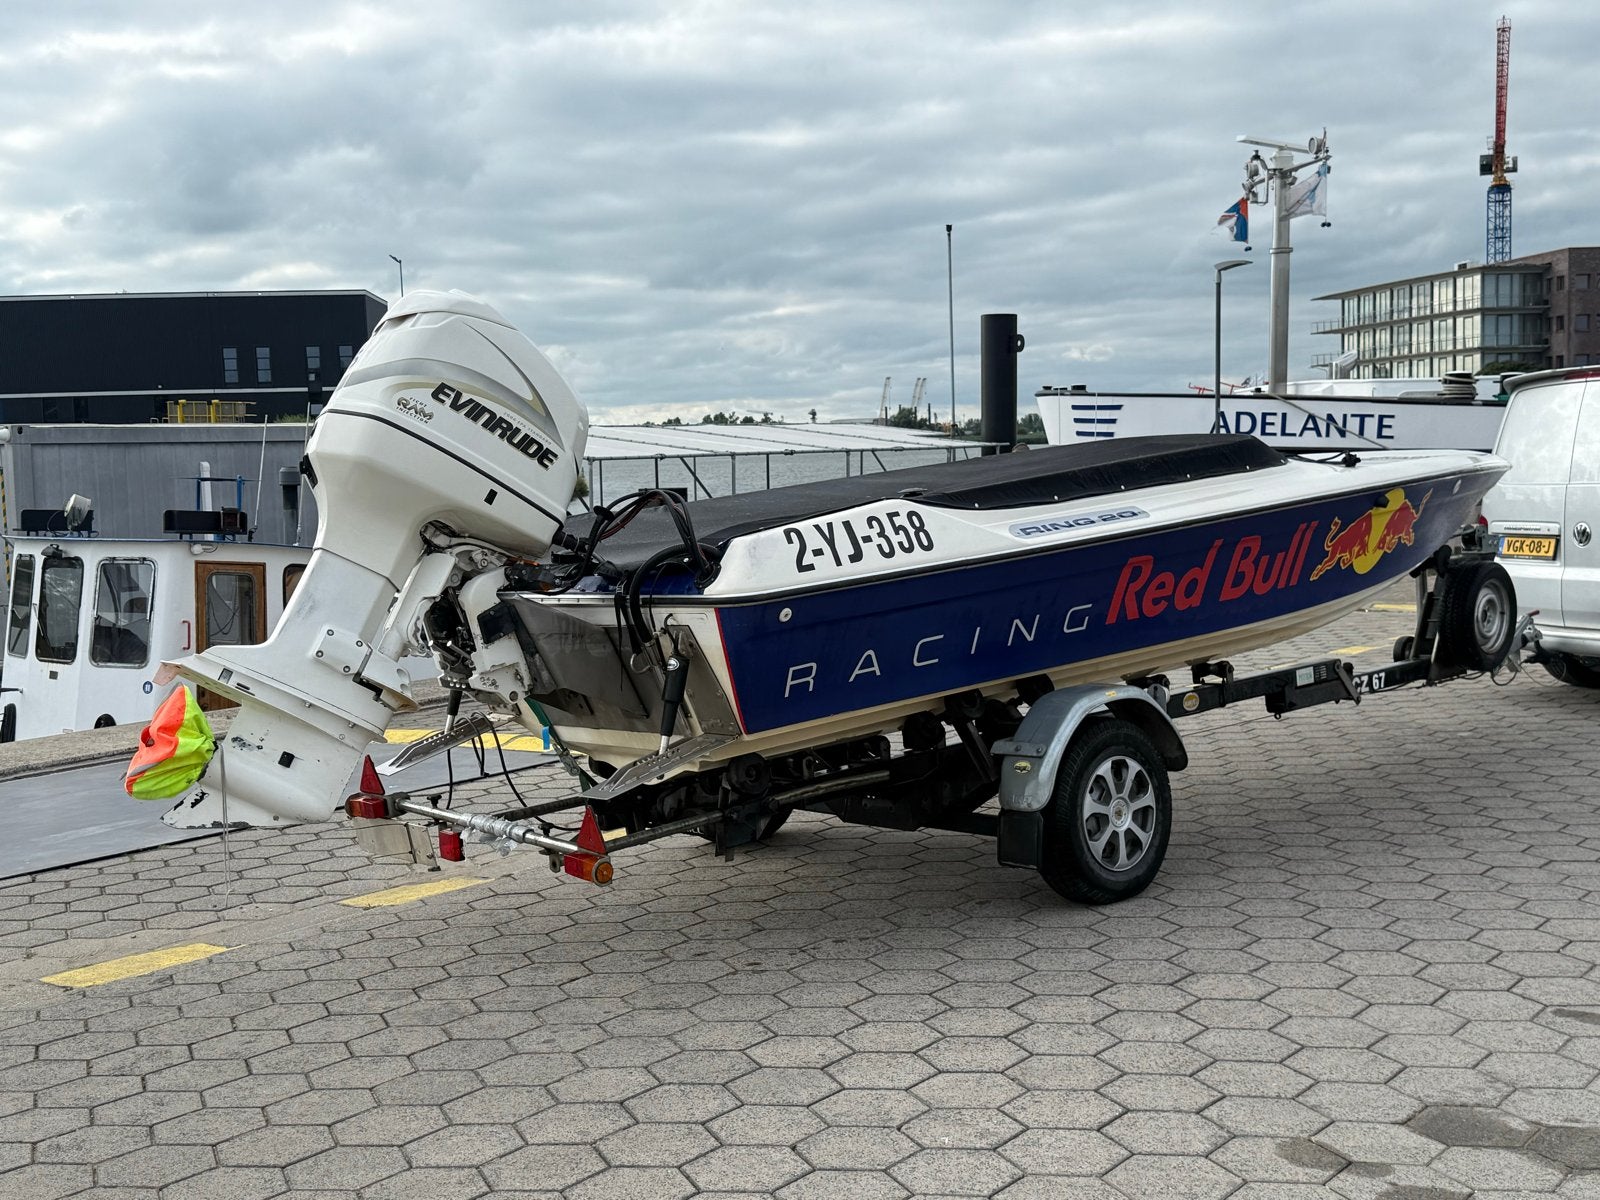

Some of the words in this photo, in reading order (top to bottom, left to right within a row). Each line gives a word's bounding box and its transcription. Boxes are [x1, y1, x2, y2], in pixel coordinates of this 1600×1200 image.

[397, 397, 434, 420] RAM
[431, 382, 559, 471] EVINRUDE
[1210, 411, 1396, 440] ADELANTE
[1019, 517, 1096, 536] RING
[1097, 510, 1139, 522] 20
[783, 510, 934, 573] 2-YJ-358
[1506, 539, 1551, 555] VGK-08-J
[1105, 538, 1224, 625] Red
[1219, 520, 1318, 601] Bull
[784, 603, 1093, 698] RACING
[1372, 672, 1386, 690] 67
